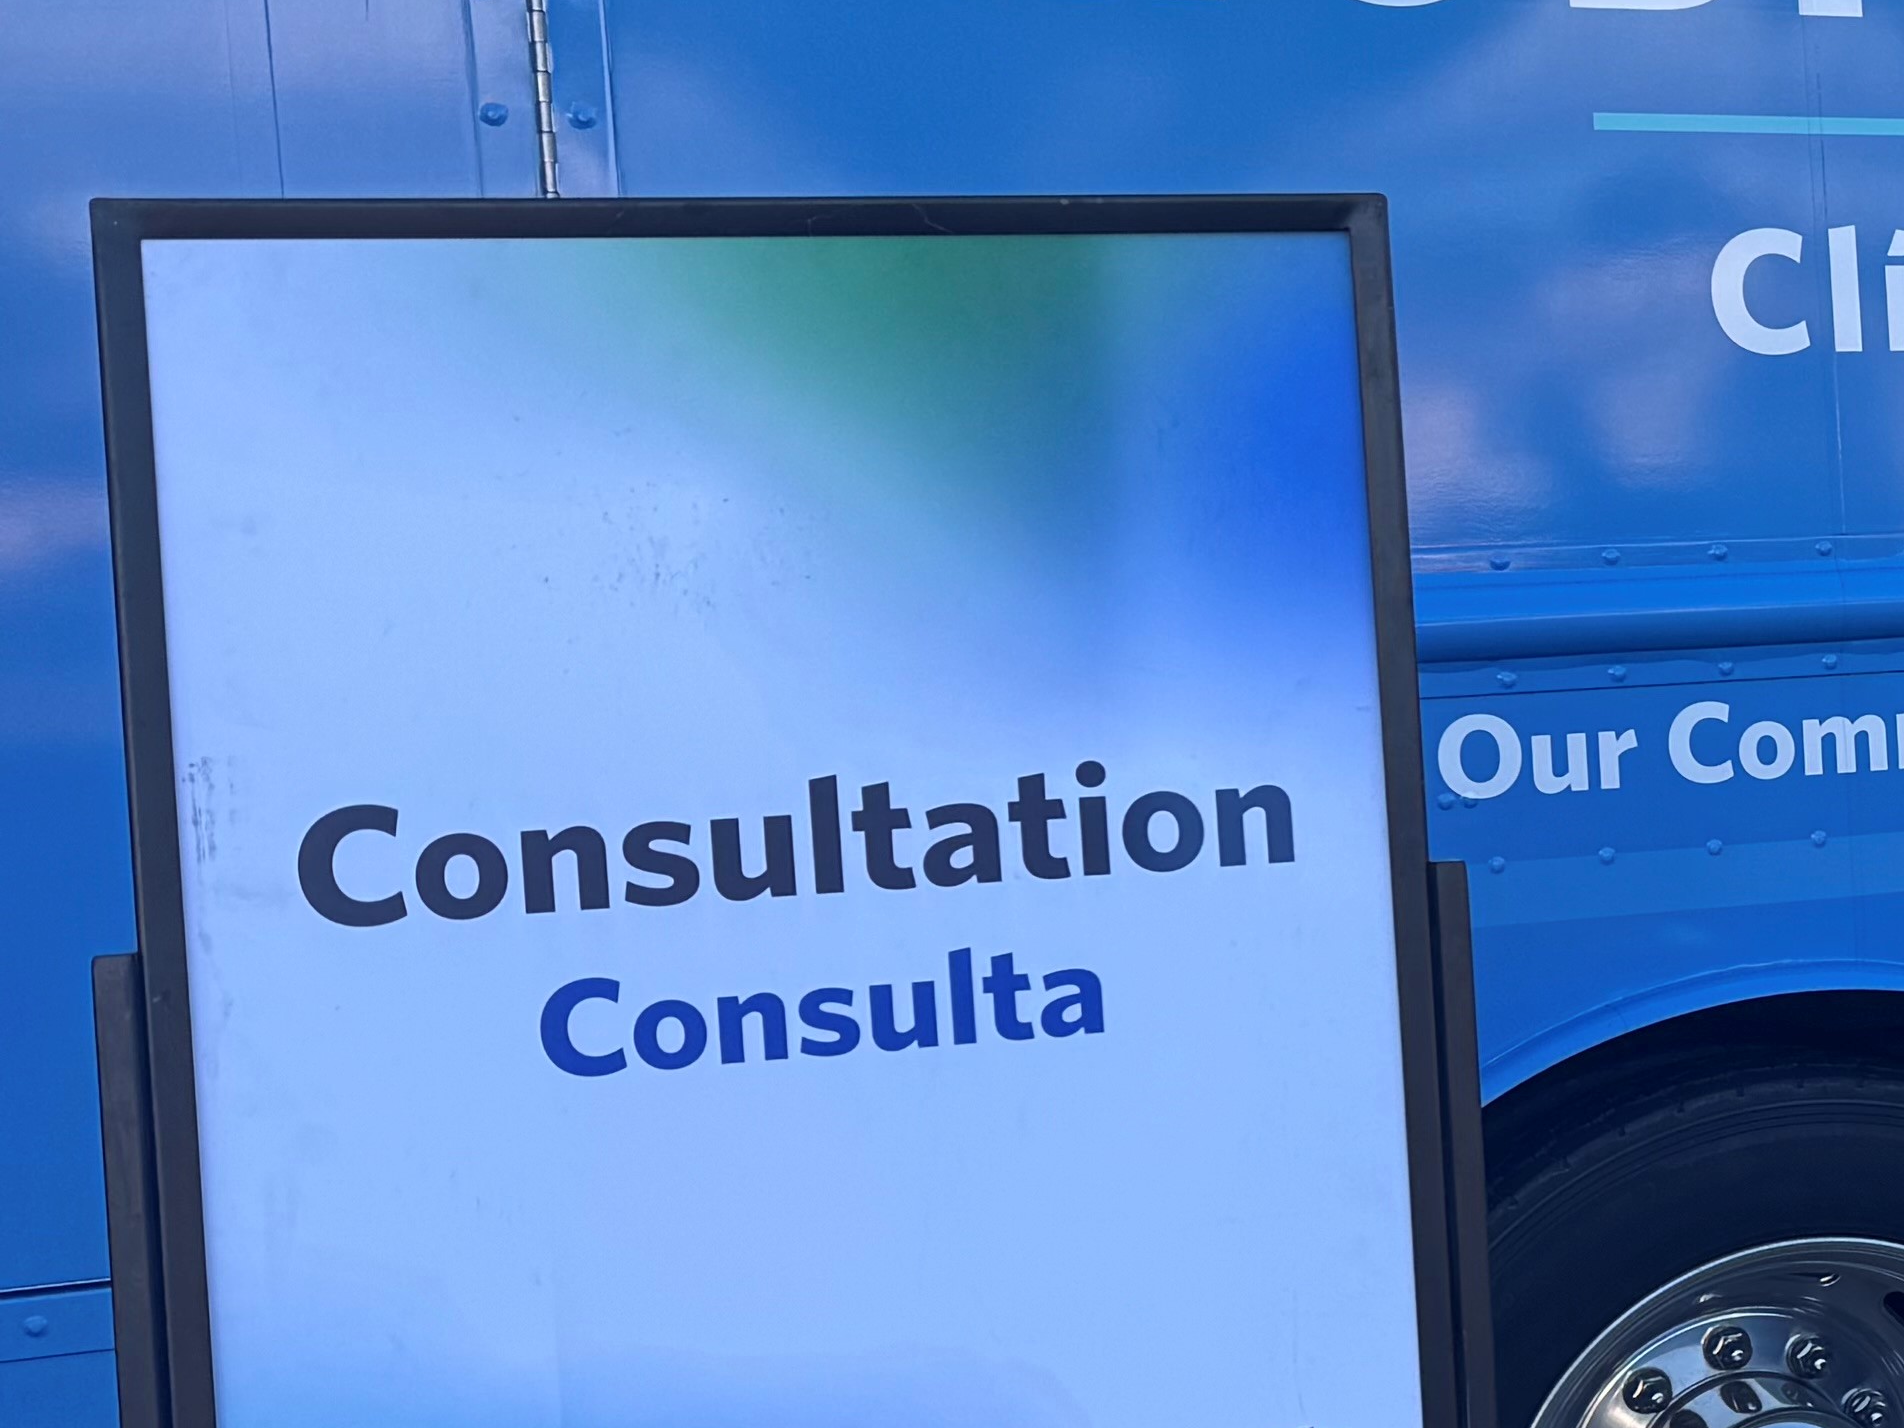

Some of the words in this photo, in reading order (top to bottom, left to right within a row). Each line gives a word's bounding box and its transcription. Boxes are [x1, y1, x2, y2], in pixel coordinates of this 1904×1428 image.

[1437, 713, 1638, 800] Our
[298, 760, 1296, 928] Consultation
[540, 946, 1105, 1078] Consulta
